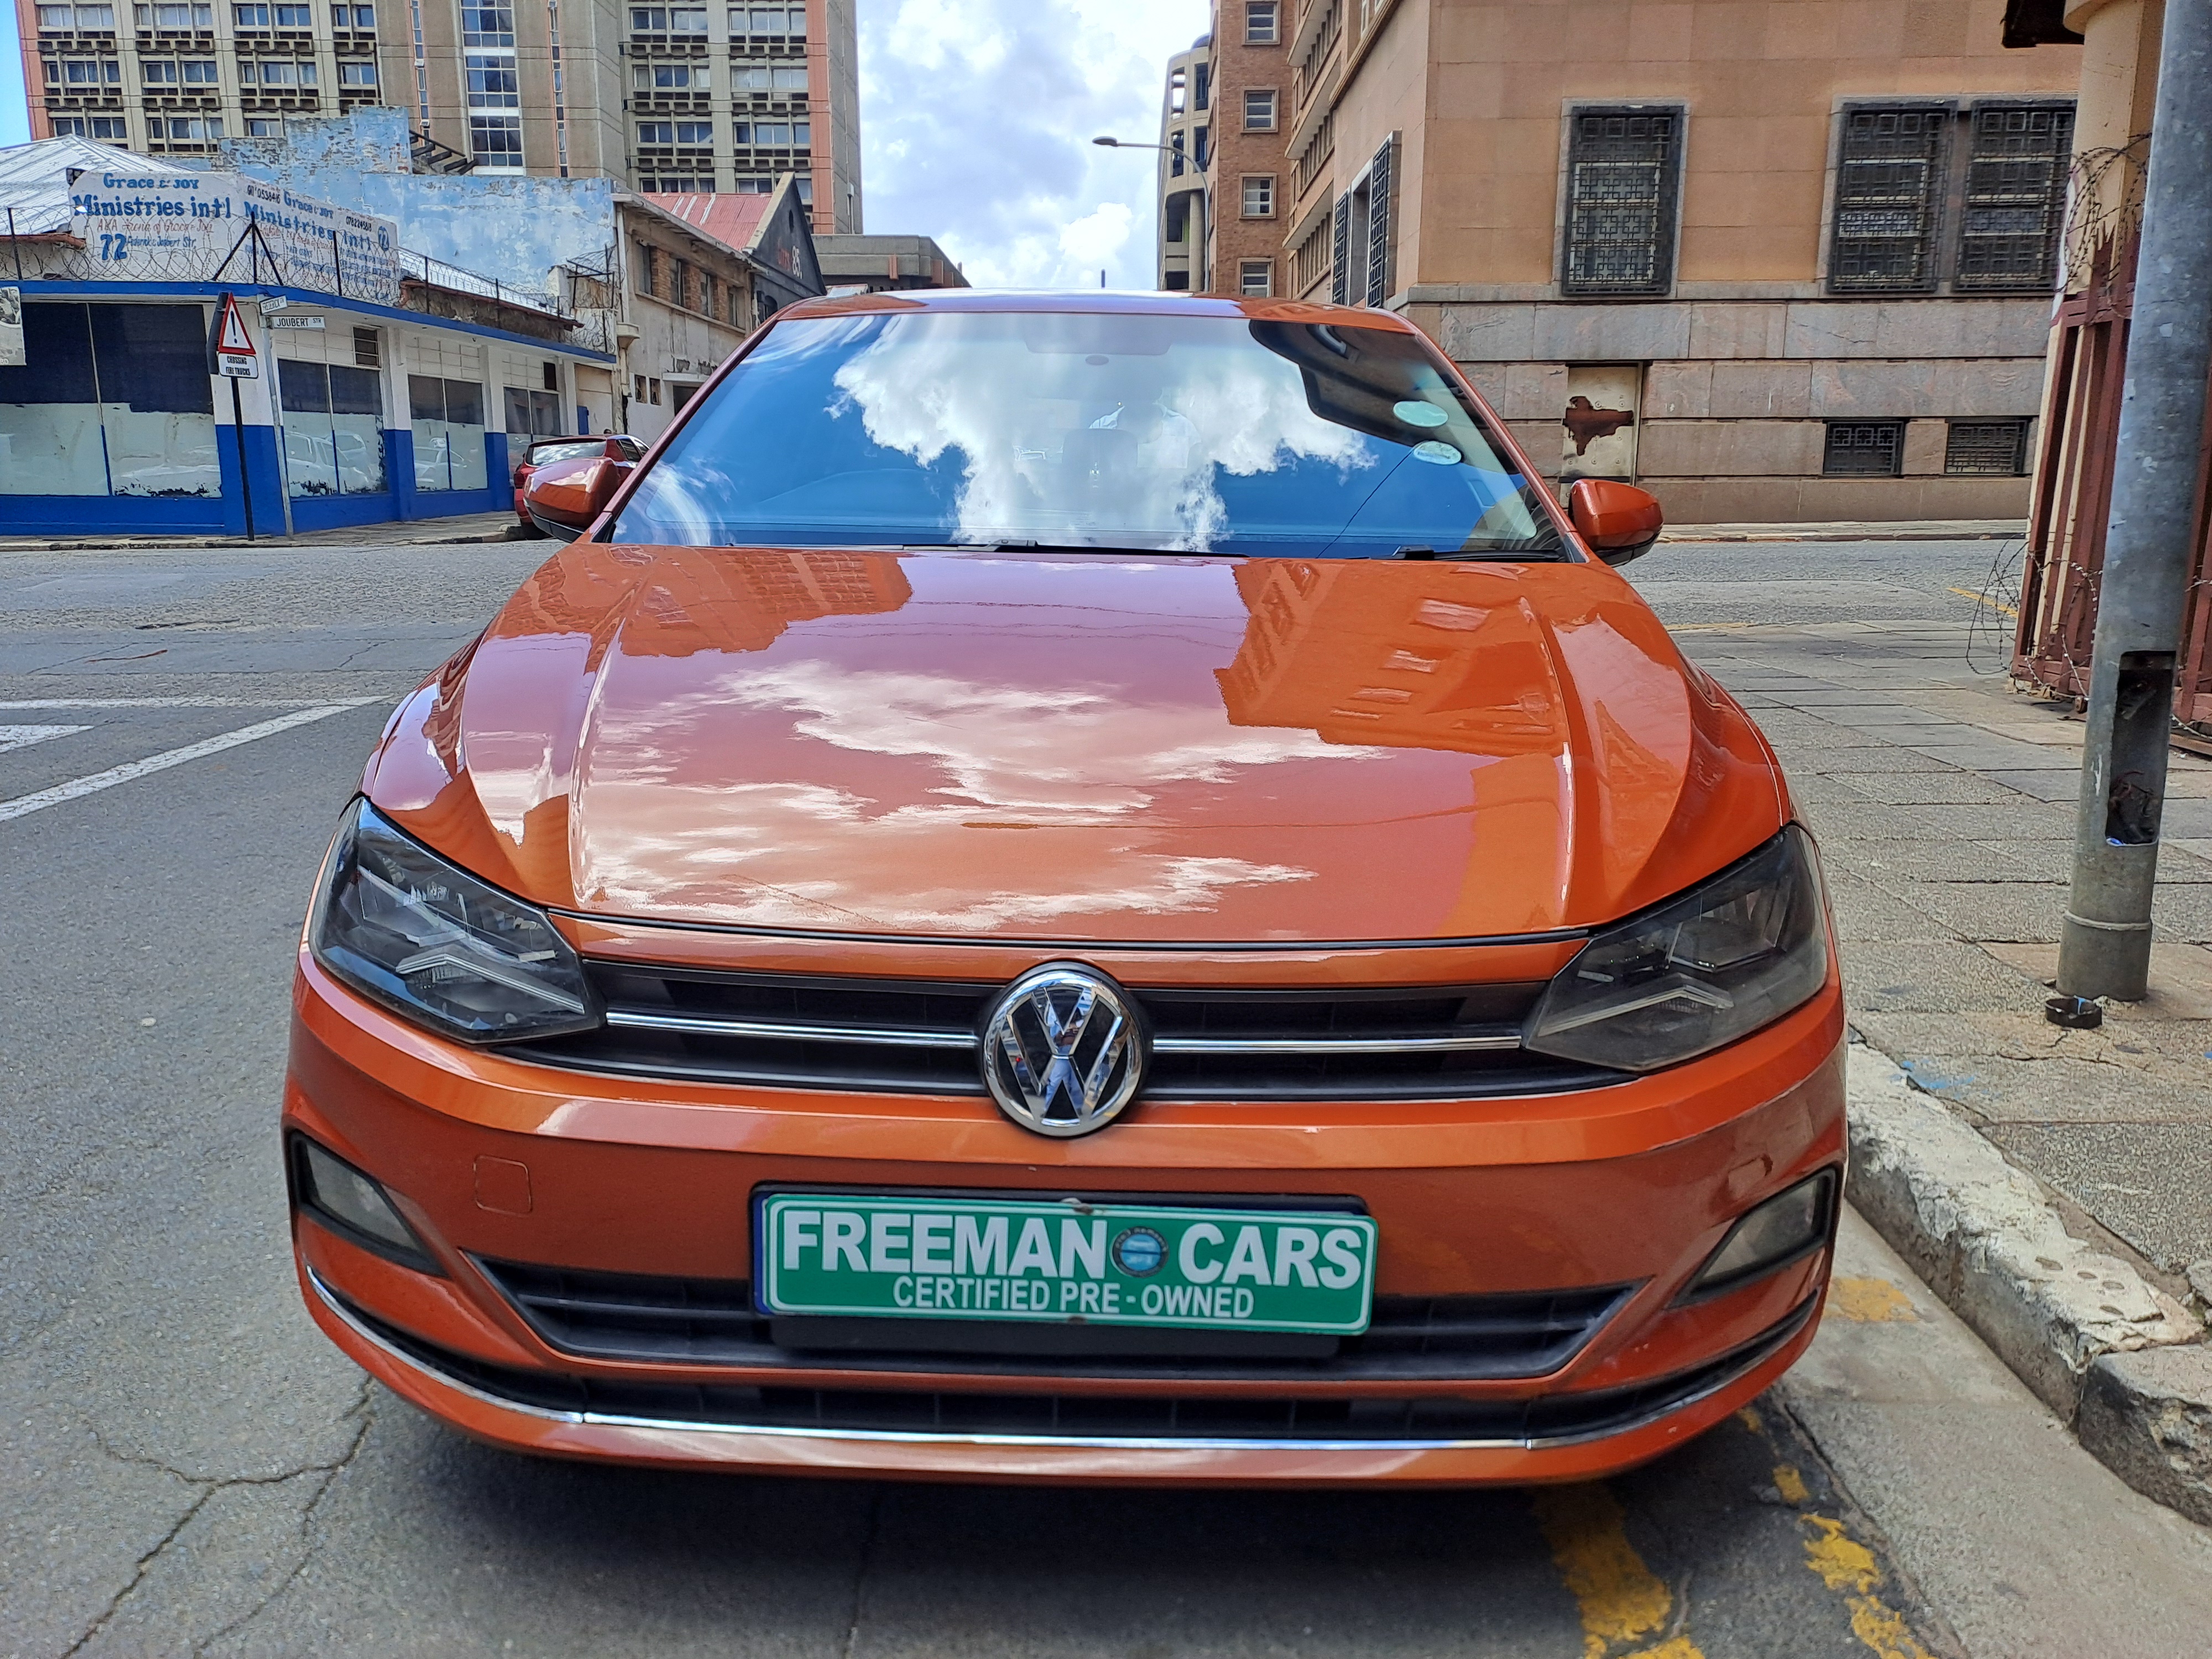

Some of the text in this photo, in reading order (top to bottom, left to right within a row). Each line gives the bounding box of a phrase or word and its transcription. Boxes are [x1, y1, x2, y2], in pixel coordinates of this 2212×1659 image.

[103, 173, 154, 189] Grace
[72, 195, 185, 216] Ministries
[284, 191, 313, 213] Grace
[244, 201, 333, 241] Ministries
[100, 233, 127, 261] 72
[277, 318, 309, 327] JOUBERT
[227, 356, 247, 365] CROSSING
[234, 367, 251, 375] TRUCKS
[782, 1211, 1108, 1279] FREEMAN
[1178, 1222, 1361, 1288] CARS
[893, 1276, 1050, 1313] CERTIFIED
[1141, 1284, 1255, 1320] OWNED
